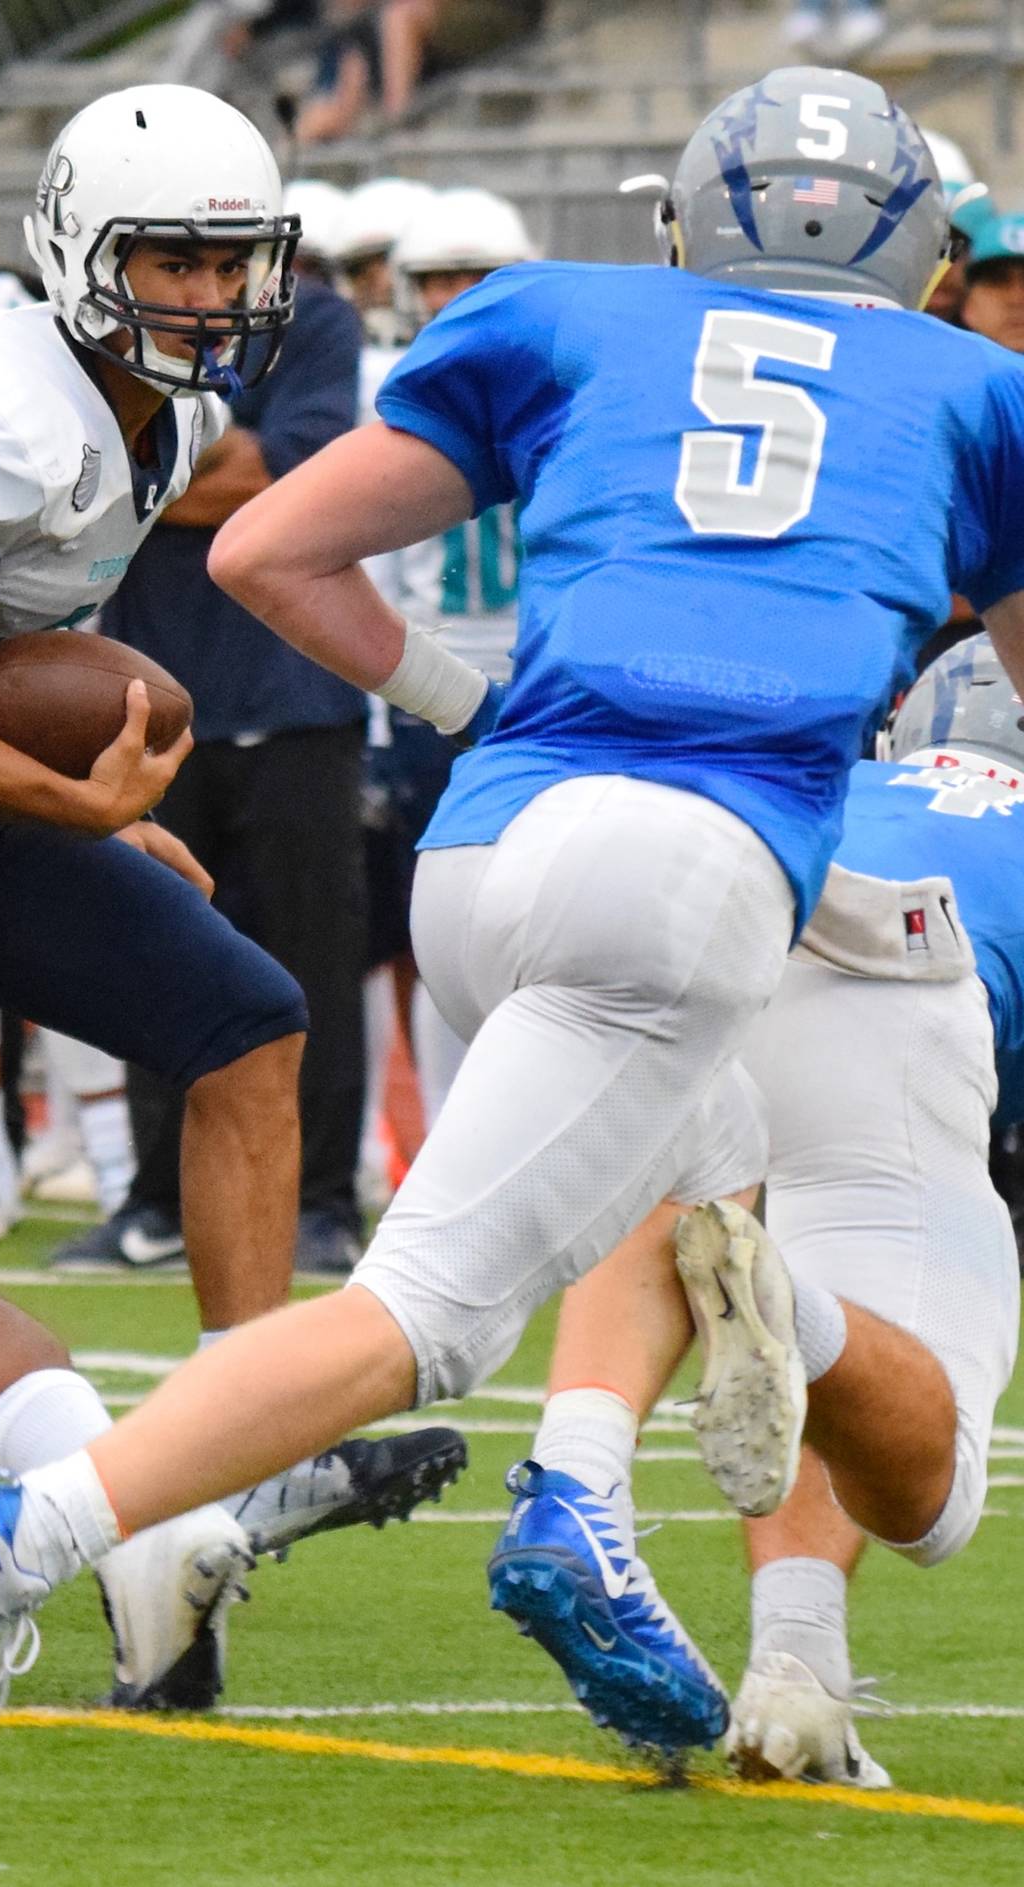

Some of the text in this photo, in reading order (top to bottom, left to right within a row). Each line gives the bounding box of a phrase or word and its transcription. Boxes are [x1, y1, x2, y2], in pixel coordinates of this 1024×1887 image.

[795, 93, 850, 160] 5
[208, 198, 250, 211] Riddell
[675, 310, 837, 538] 5
